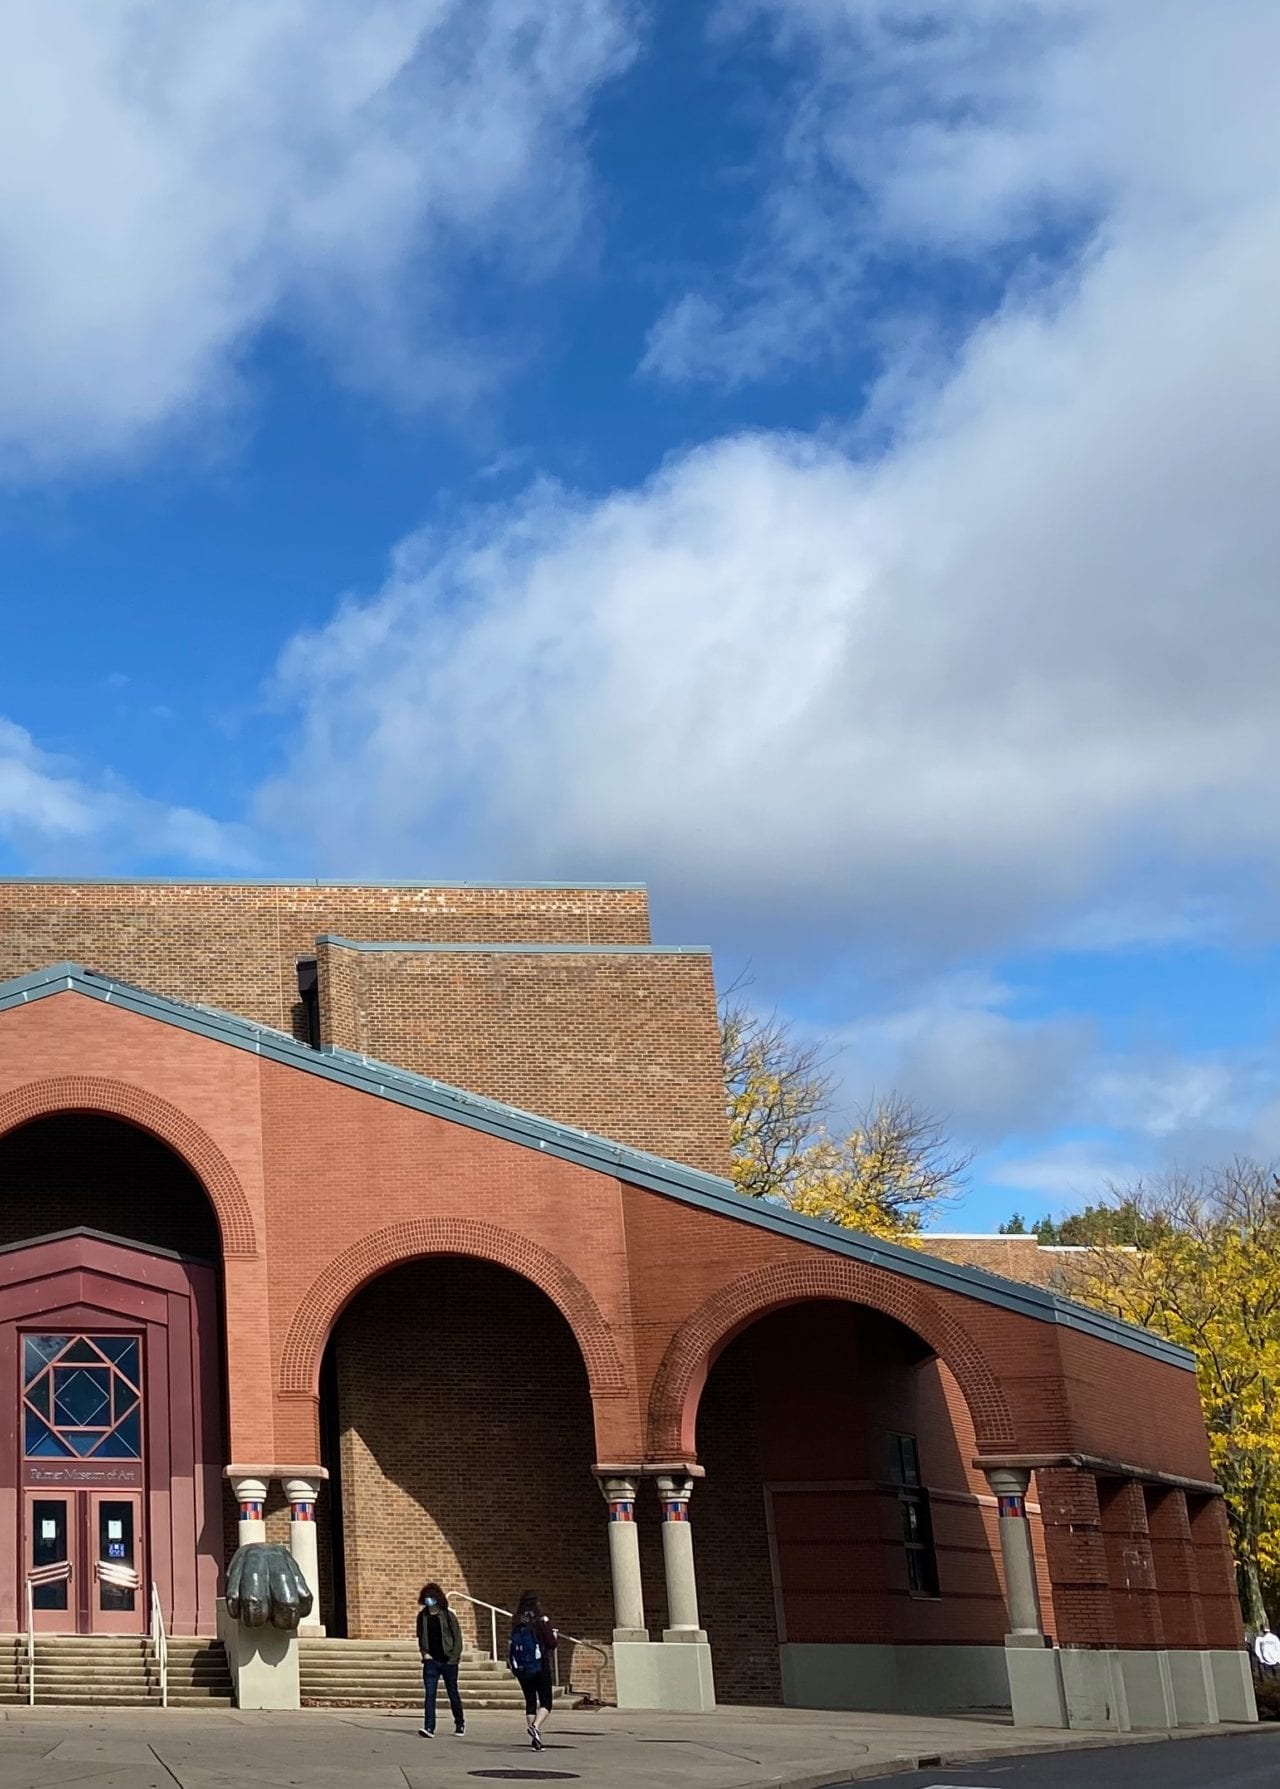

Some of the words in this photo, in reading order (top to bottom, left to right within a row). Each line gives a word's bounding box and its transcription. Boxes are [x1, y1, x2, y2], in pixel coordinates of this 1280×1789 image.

[64, 1469, 106, 1480] Museum
[106, 1468, 118, 1480] of
[118, 1469, 136, 1480] Art
